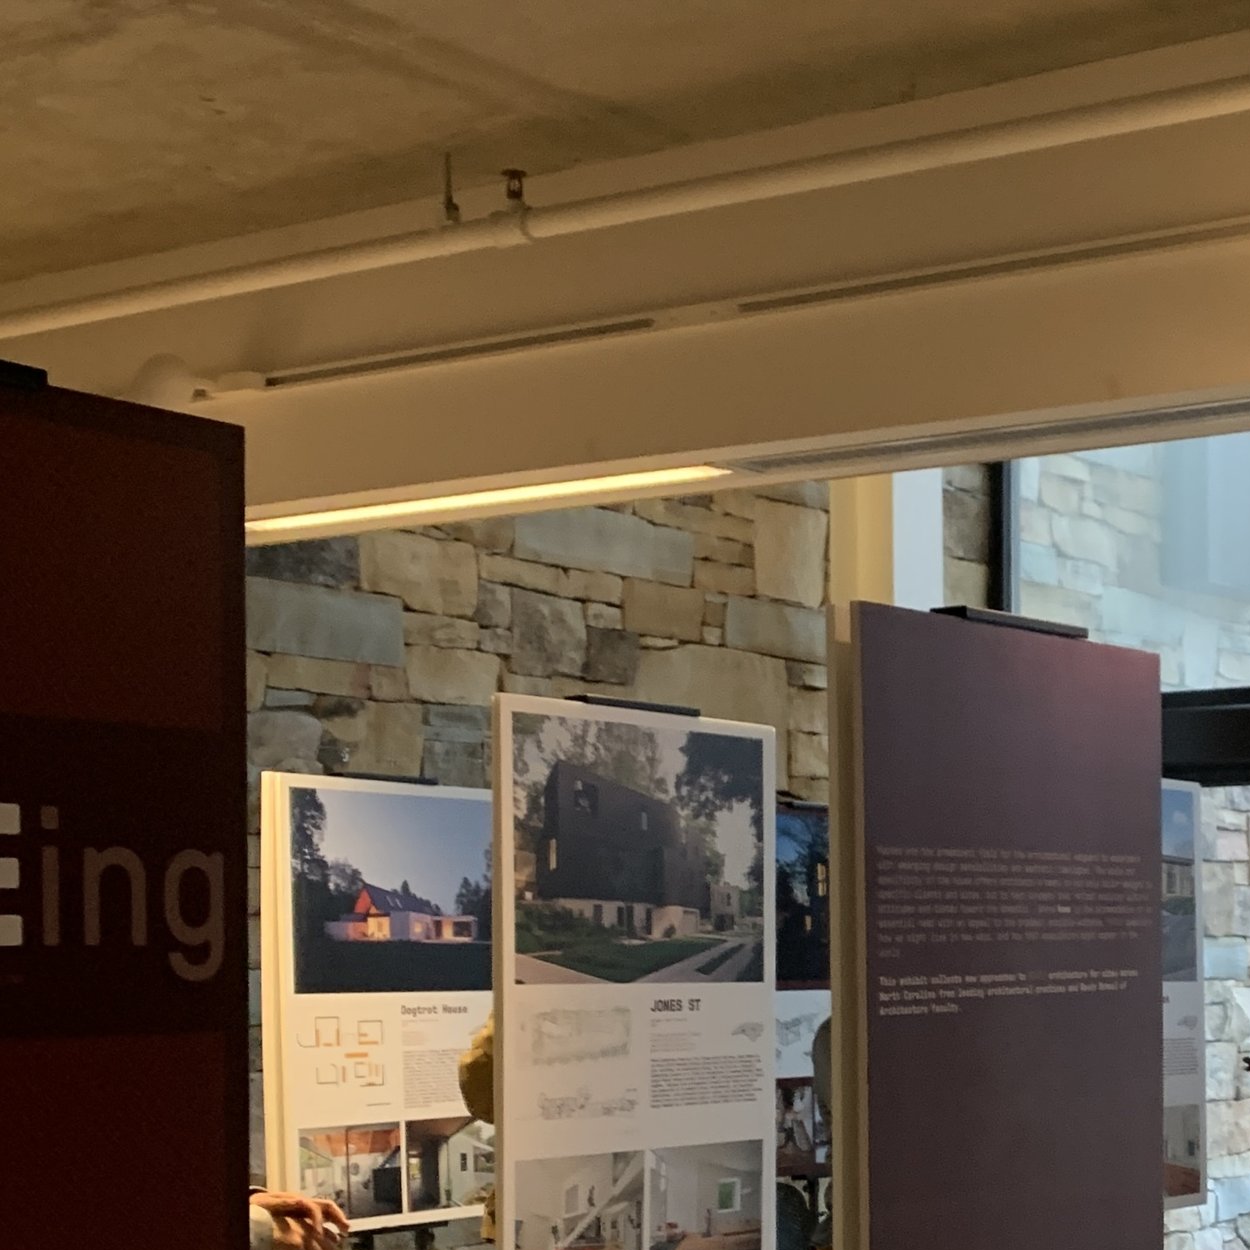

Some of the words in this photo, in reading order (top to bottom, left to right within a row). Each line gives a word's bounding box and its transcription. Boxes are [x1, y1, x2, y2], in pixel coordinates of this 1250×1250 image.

[400, 1004, 438, 1017] Dogtrot
[442, 1004, 468, 1014] House
[650, 998, 683, 1012] JONES
[687, 998, 702, 1011] ST
